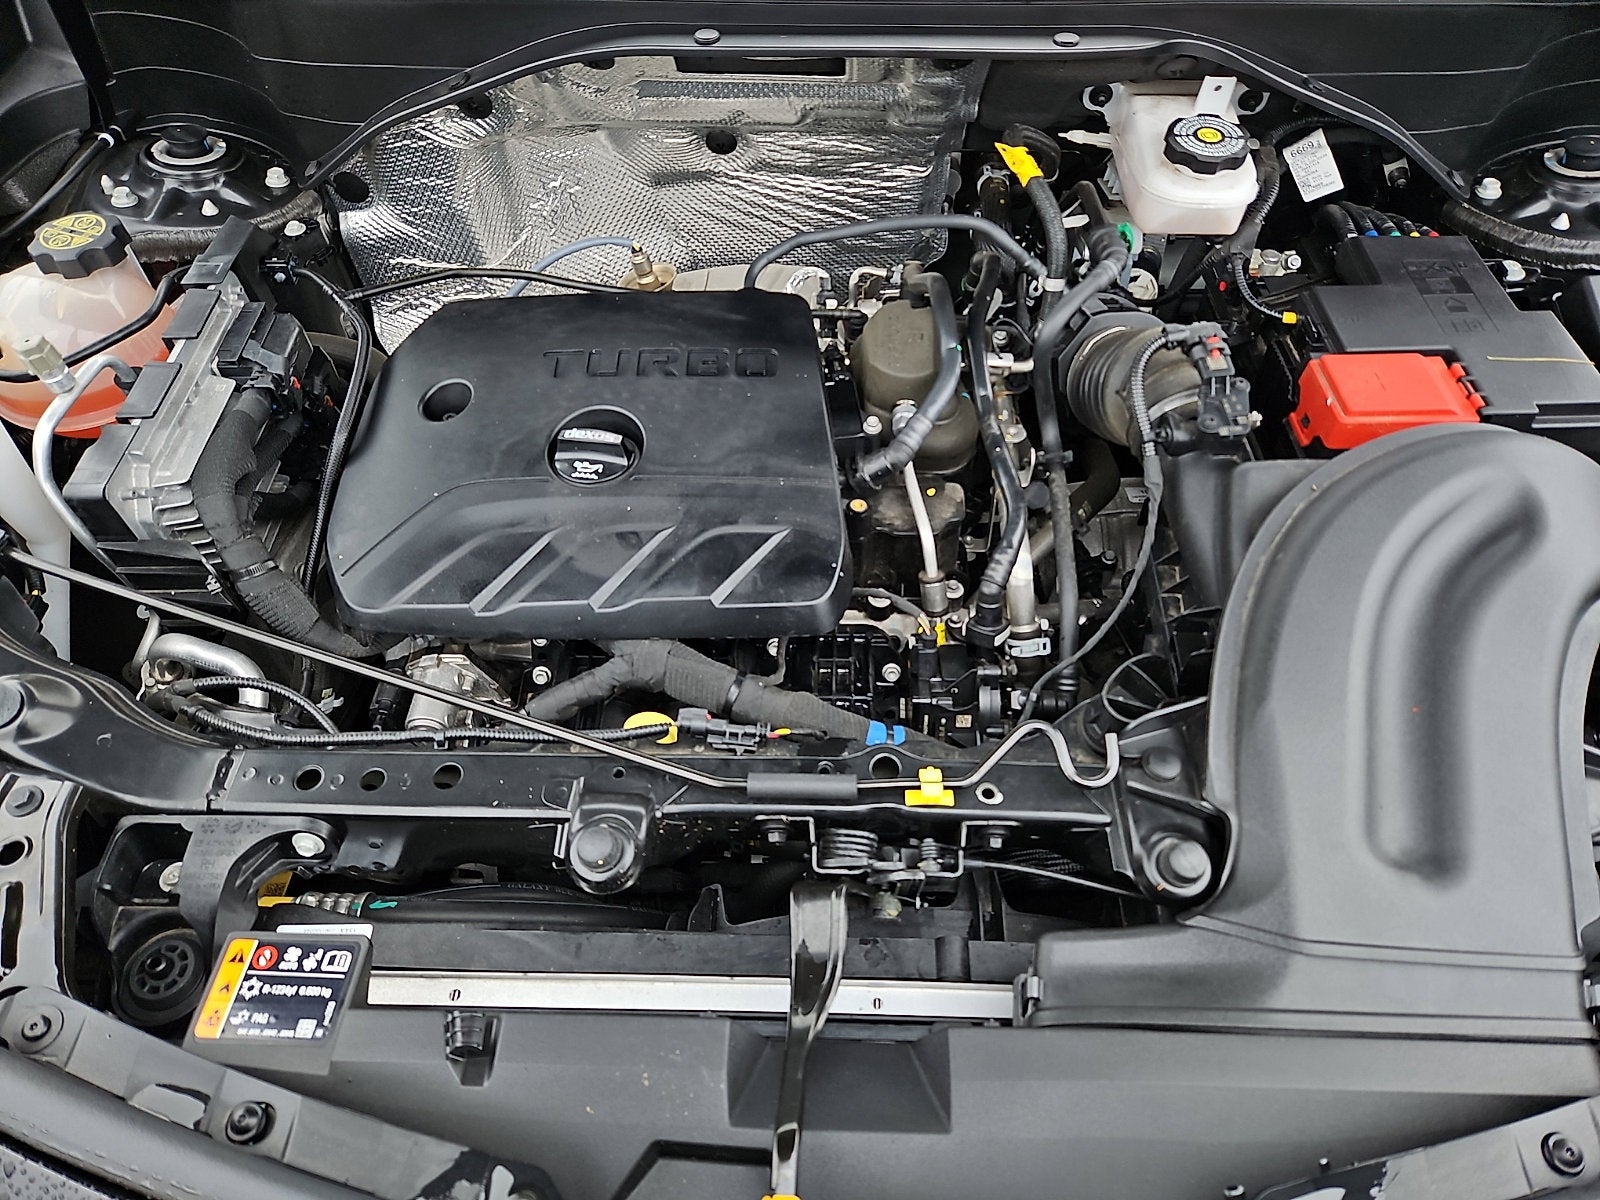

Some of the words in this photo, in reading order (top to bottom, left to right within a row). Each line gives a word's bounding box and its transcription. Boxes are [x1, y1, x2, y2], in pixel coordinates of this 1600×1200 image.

[1290, 140, 1315, 158] 6669
[543, 347, 779, 378] TURBO
[563, 428, 622, 444] dexos
